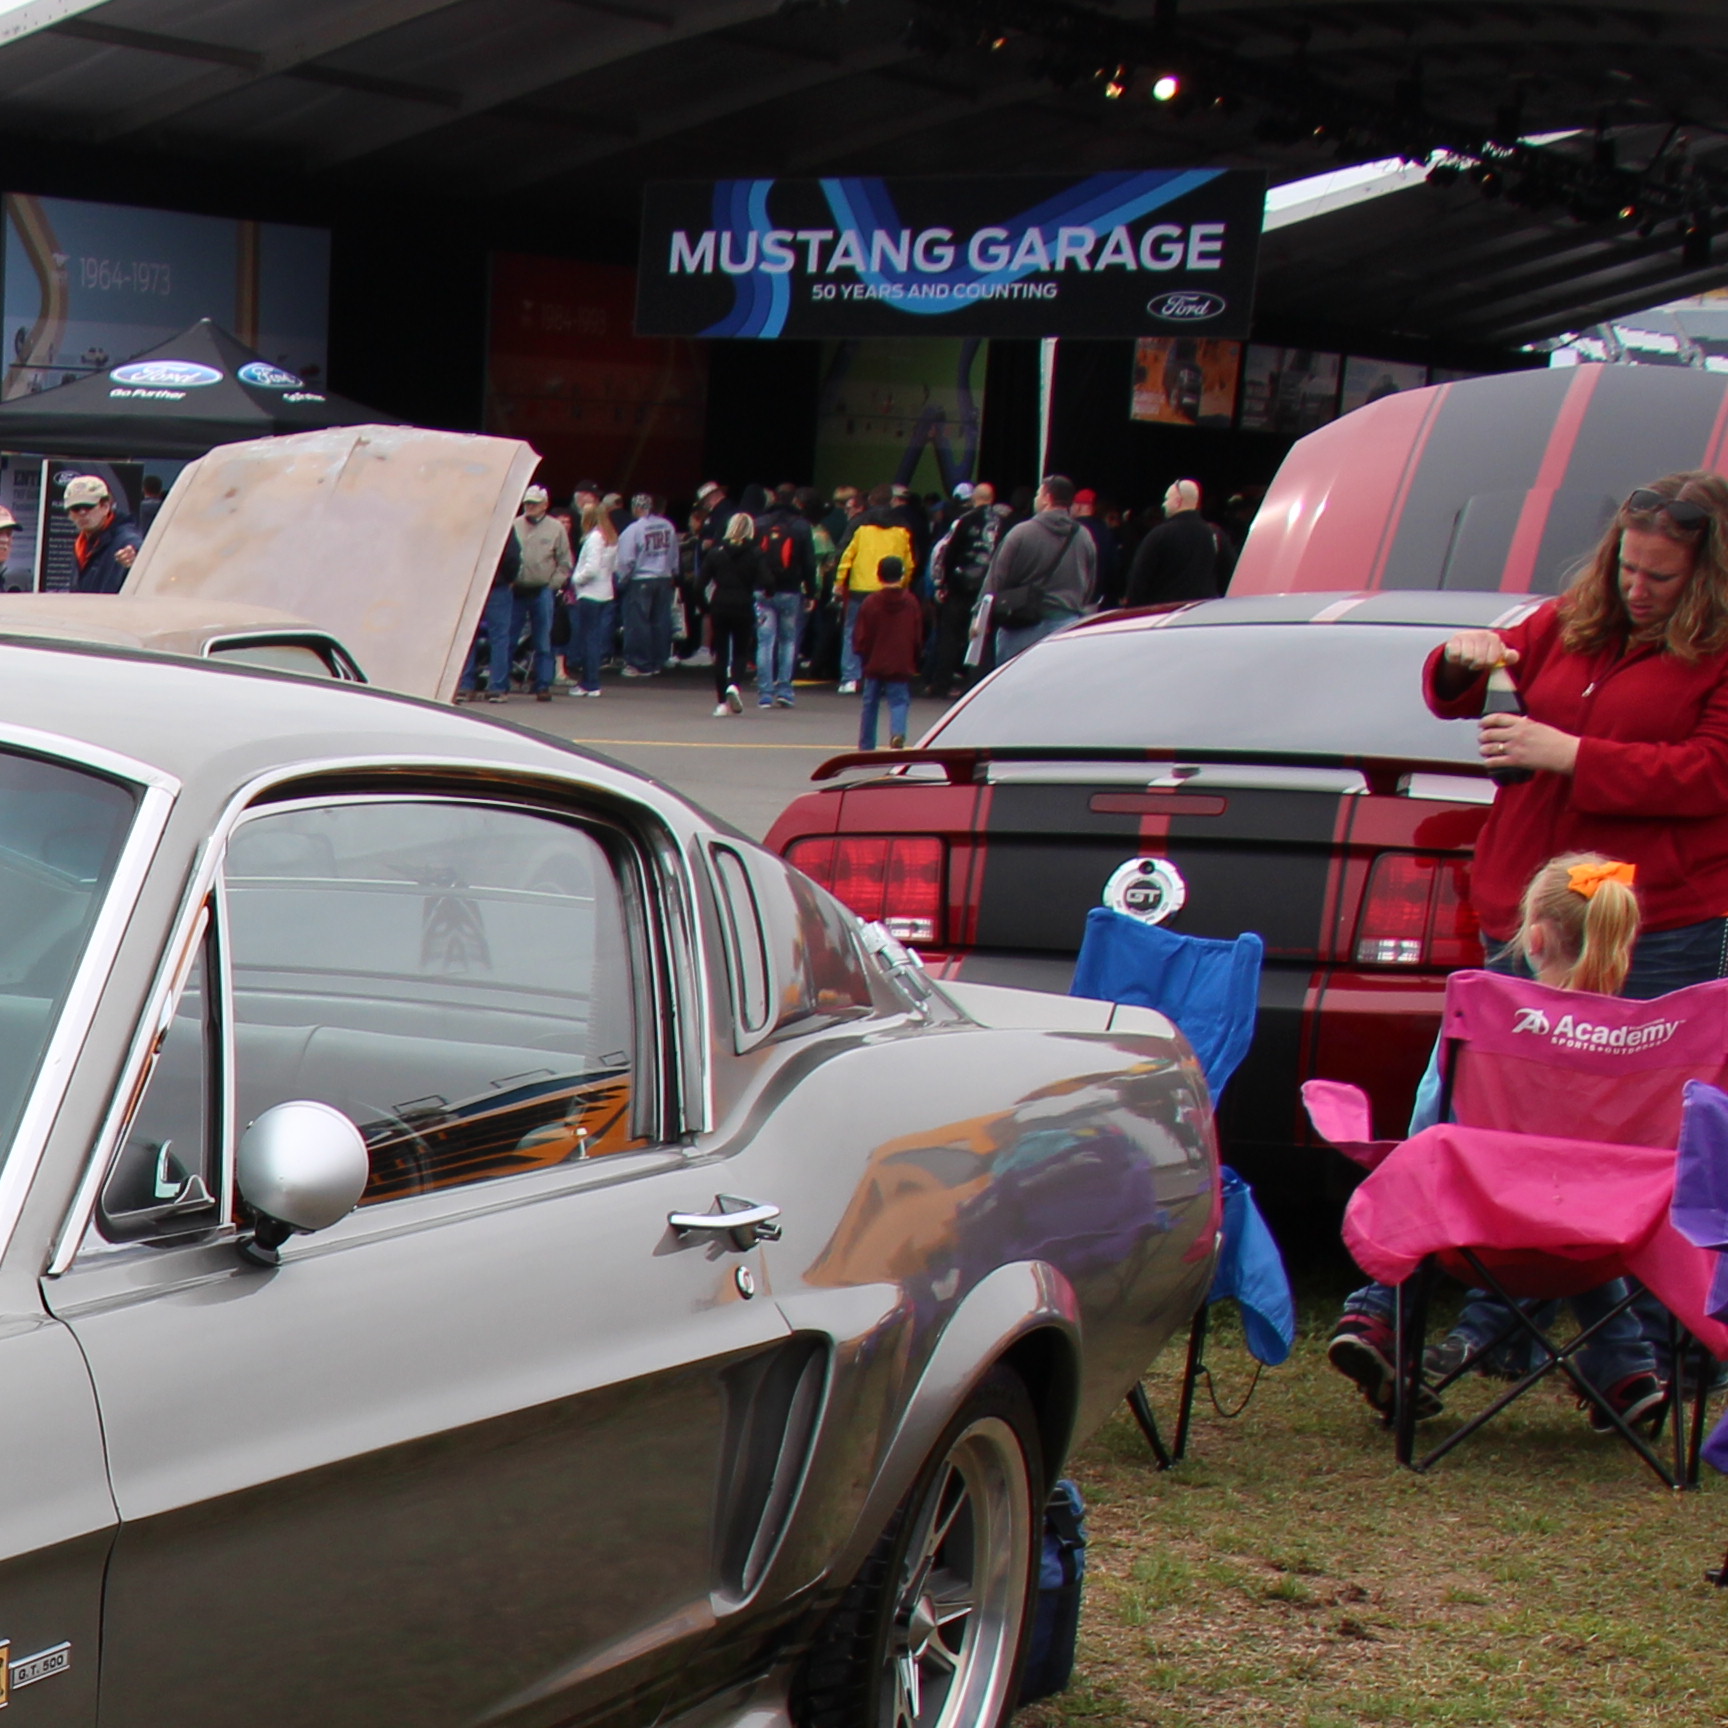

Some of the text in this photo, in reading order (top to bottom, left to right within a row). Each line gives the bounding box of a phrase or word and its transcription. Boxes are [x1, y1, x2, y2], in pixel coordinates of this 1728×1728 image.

[668, 223, 1225, 275] MUSTANG GARAGE
[79, 256, 171, 296] 1964-1973
[811, 282, 1058, 300] 50 YEARS AND COUNTING
[1161, 295, 1211, 317] Ford
[131, 366, 201, 384] Ford
[109, 388, 186, 401] Go Further
[645, 530, 671, 551] FIRE
[1126, 888, 1161, 903] GT
[1553, 1015, 1679, 1047] Academy
[43, 1654, 64, 1672] 500
